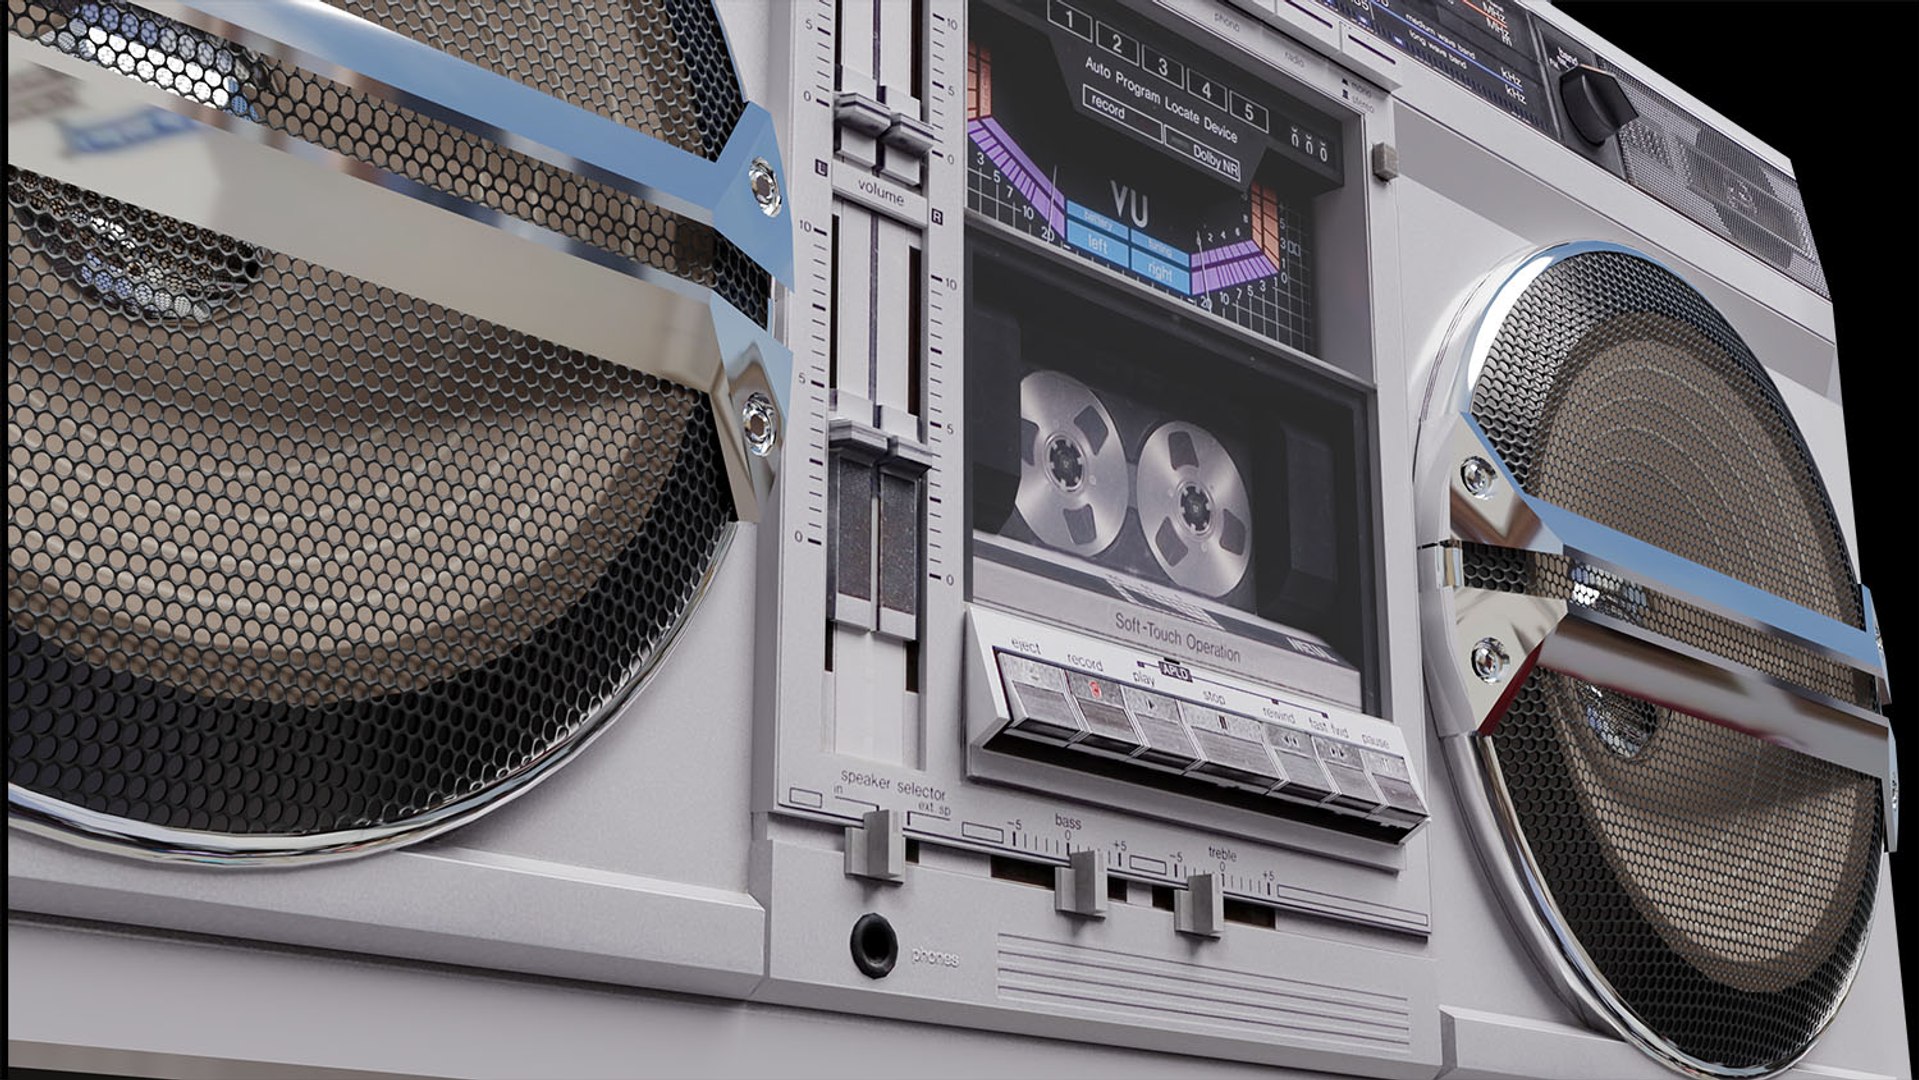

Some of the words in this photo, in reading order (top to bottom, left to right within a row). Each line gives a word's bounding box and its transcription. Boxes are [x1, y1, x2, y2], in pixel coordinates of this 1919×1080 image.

[805, 19, 813, 30] 5
[947, 18, 958, 31] 10
[1065, 11, 1073, 28] 1
[1112, 34, 1123, 53] 2
[1158, 58, 1169, 76] 3
[803, 90, 812, 102] 0
[948, 86, 955, 96] 5
[1202, 82, 1212, 99] 4
[1085, 56, 1111, 79] Auto
[1116, 71, 1161, 105] Program
[1165, 96, 1200, 124] Locate
[1204, 116, 1239, 143] Device
[1091, 94, 1126, 120] record
[1244, 103, 1254, 121] 5
[947, 153, 955, 165] 0
[976, 152, 985, 165] 3
[1193, 144, 1222, 171] Dolby
[1222, 160, 1239, 177] NR
[993, 170, 1001, 183] 5
[858, 178, 905, 206] volume
[1006, 185, 1014, 199] 7
[1110, 180, 1148, 228] VU
[1023, 205, 1035, 220] 10
[799, 219, 812, 232] 10
[1041, 226, 1055, 242] 20
[1088, 234, 1108, 256] left
[1280, 238, 1287, 249] 3
[1148, 260, 1173, 283] right
[1281, 272, 1288, 284] 0
[946, 278, 957, 290] 10
[1247, 285, 1254, 297] 5
[1259, 280, 1267, 292] 3
[1220, 291, 1230, 306] 10
[1236, 287, 1242, 300] 7
[798, 373, 806, 385] 5
[947, 423, 955, 435] 5
[794, 530, 803, 543] 0
[946, 574, 955, 586] 0
[1115, 612, 1183, 647] Soft-Touch
[1187, 633, 1242, 664] Operation
[1011, 637, 1042, 656] eject
[1067, 652, 1104, 672] record
[1132, 670, 1155, 687] play
[1202, 689, 1226, 706] stop
[1262, 706, 1297, 725] rewind
[1308, 716, 1327, 733] fast
[1361, 733, 1390, 749] pause
[834, 785, 843, 795] in
[841, 770, 891, 790] speaker
[897, 781, 946, 801] selector
[1055, 813, 1082, 831] bass
[1064, 830, 1072, 841] 0
[1114, 840, 1127, 851] +5
[1208, 845, 1238, 864] treble
[1219, 861, 1226, 872] 0
[912, 945, 960, 968] phones
